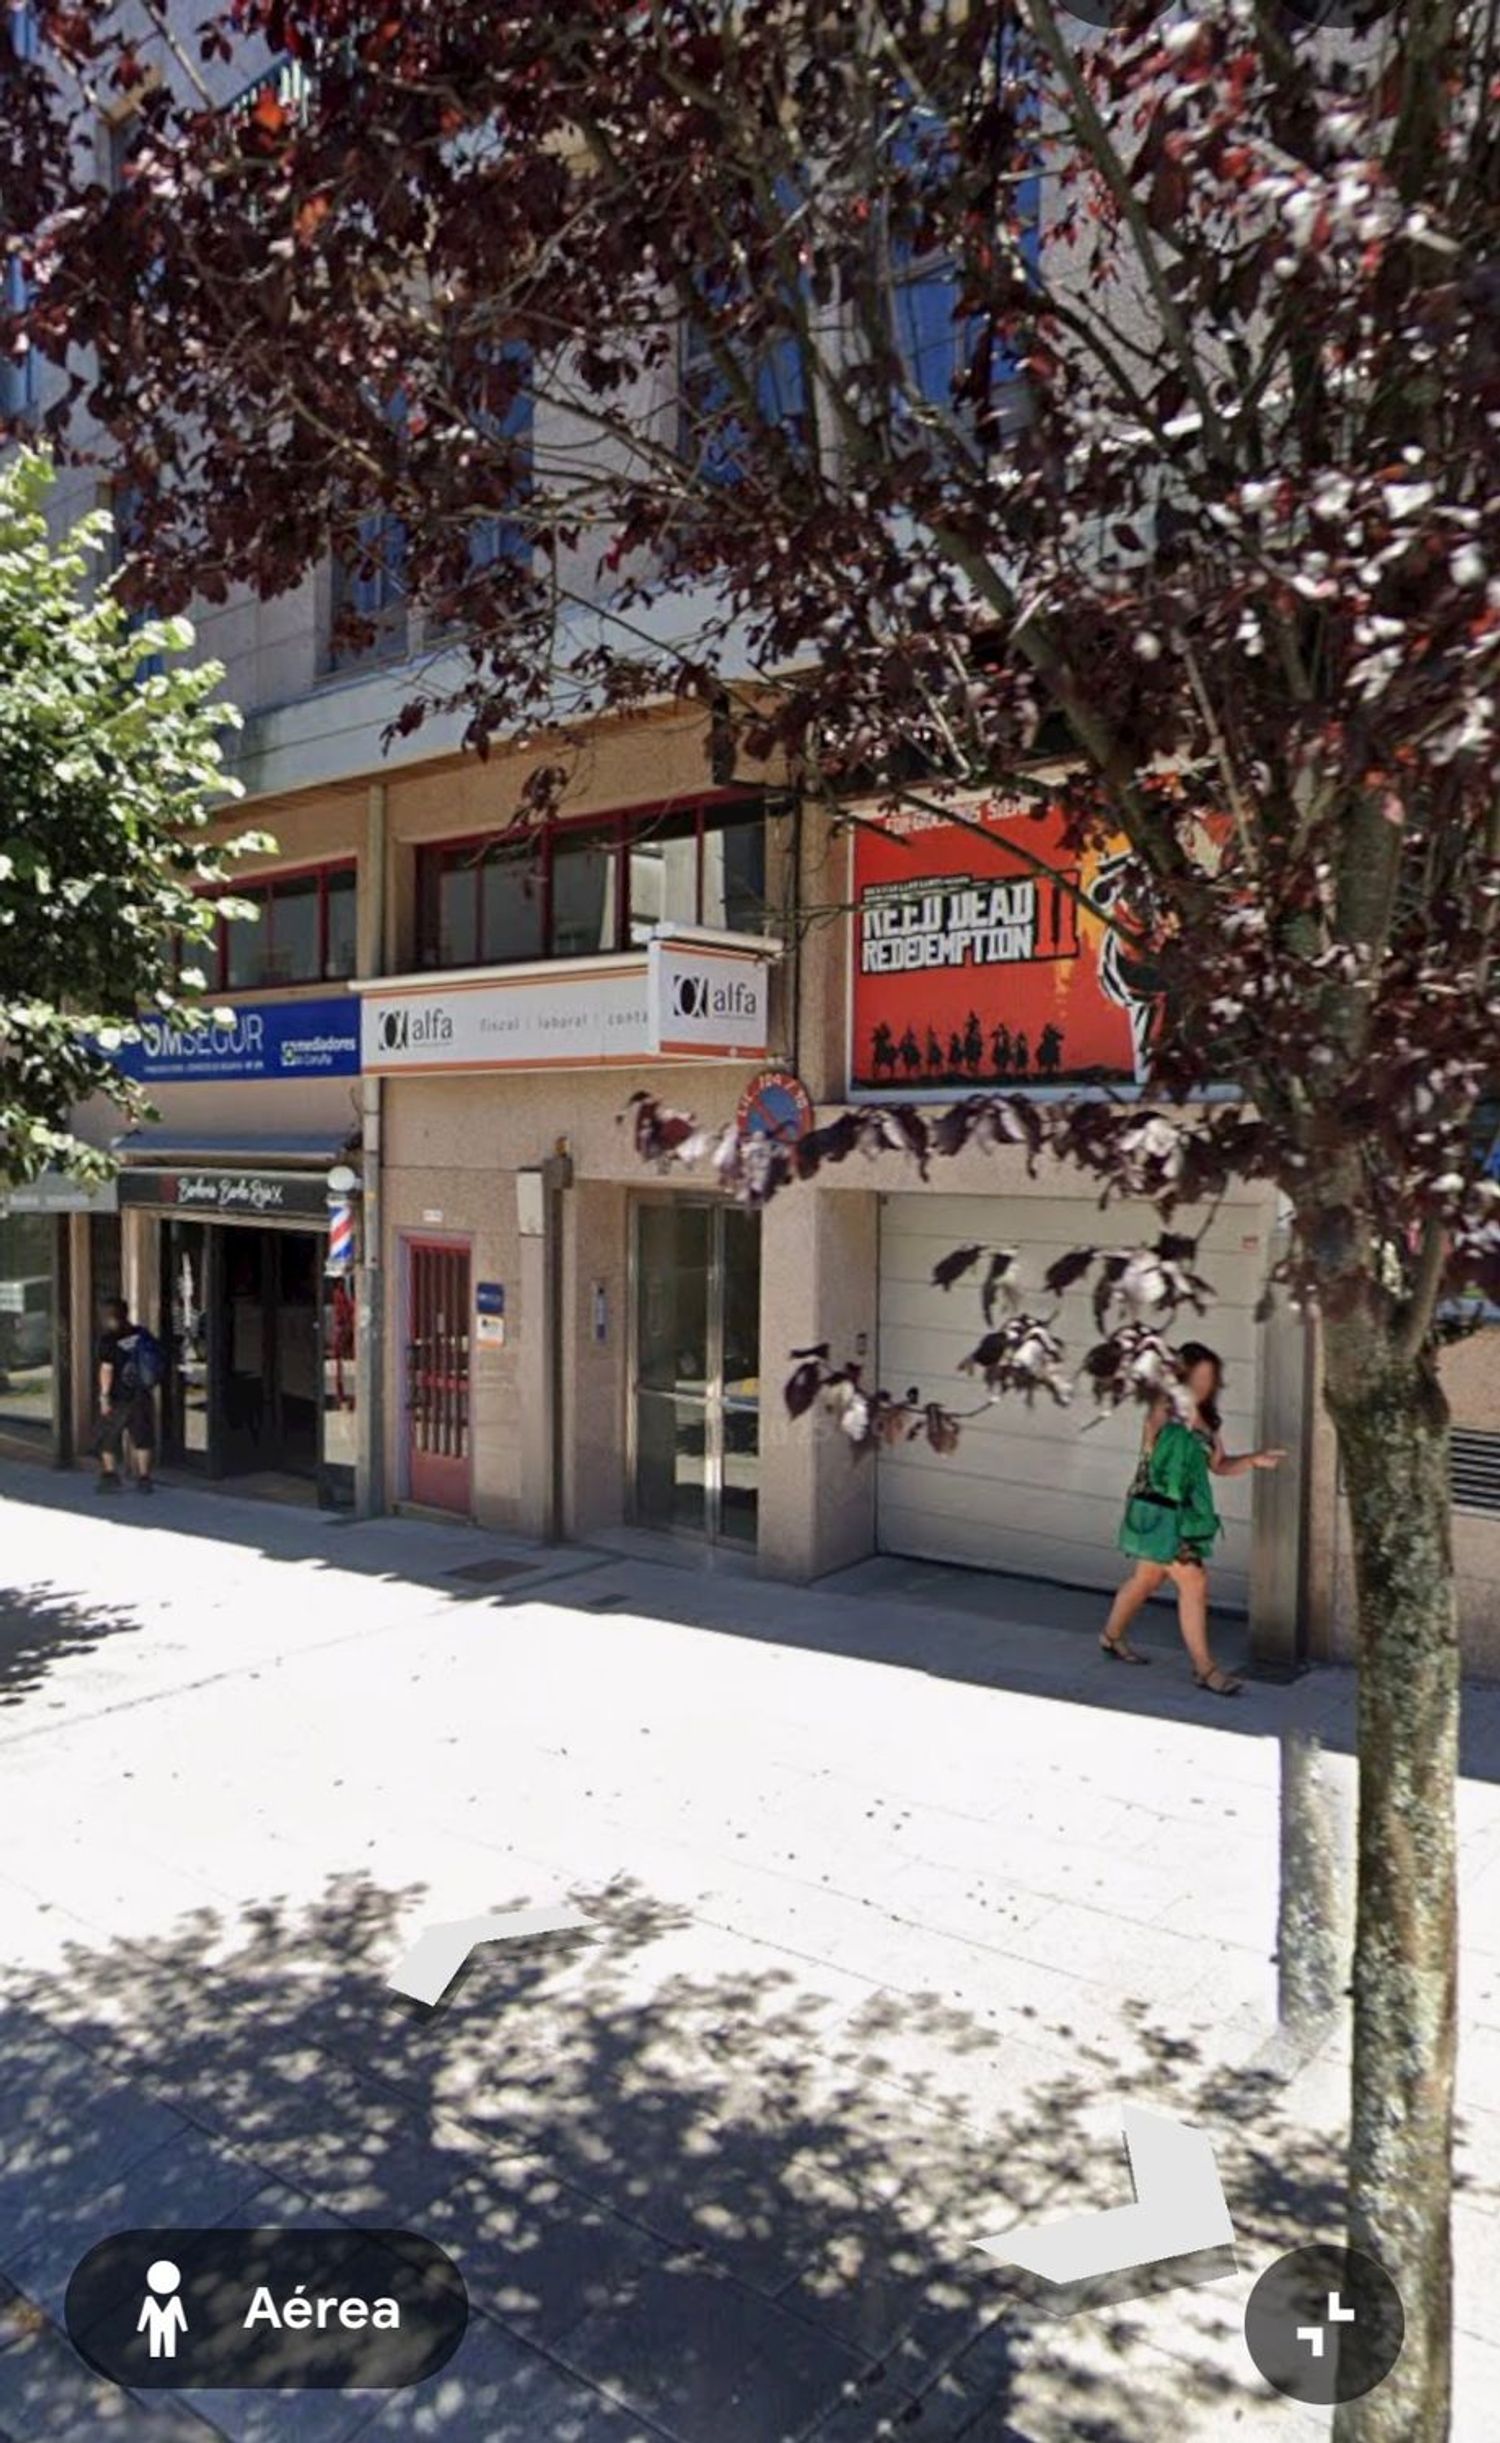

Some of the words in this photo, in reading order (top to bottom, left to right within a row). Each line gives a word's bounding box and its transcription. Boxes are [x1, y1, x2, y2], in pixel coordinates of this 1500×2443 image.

[948, 881, 1036, 930] DEAD
[713, 981, 757, 1015] alfa
[411, 1007, 453, 1040] alfa
[479, 1016, 520, 1032] fiscal
[538, 1013, 588, 1030] laboral
